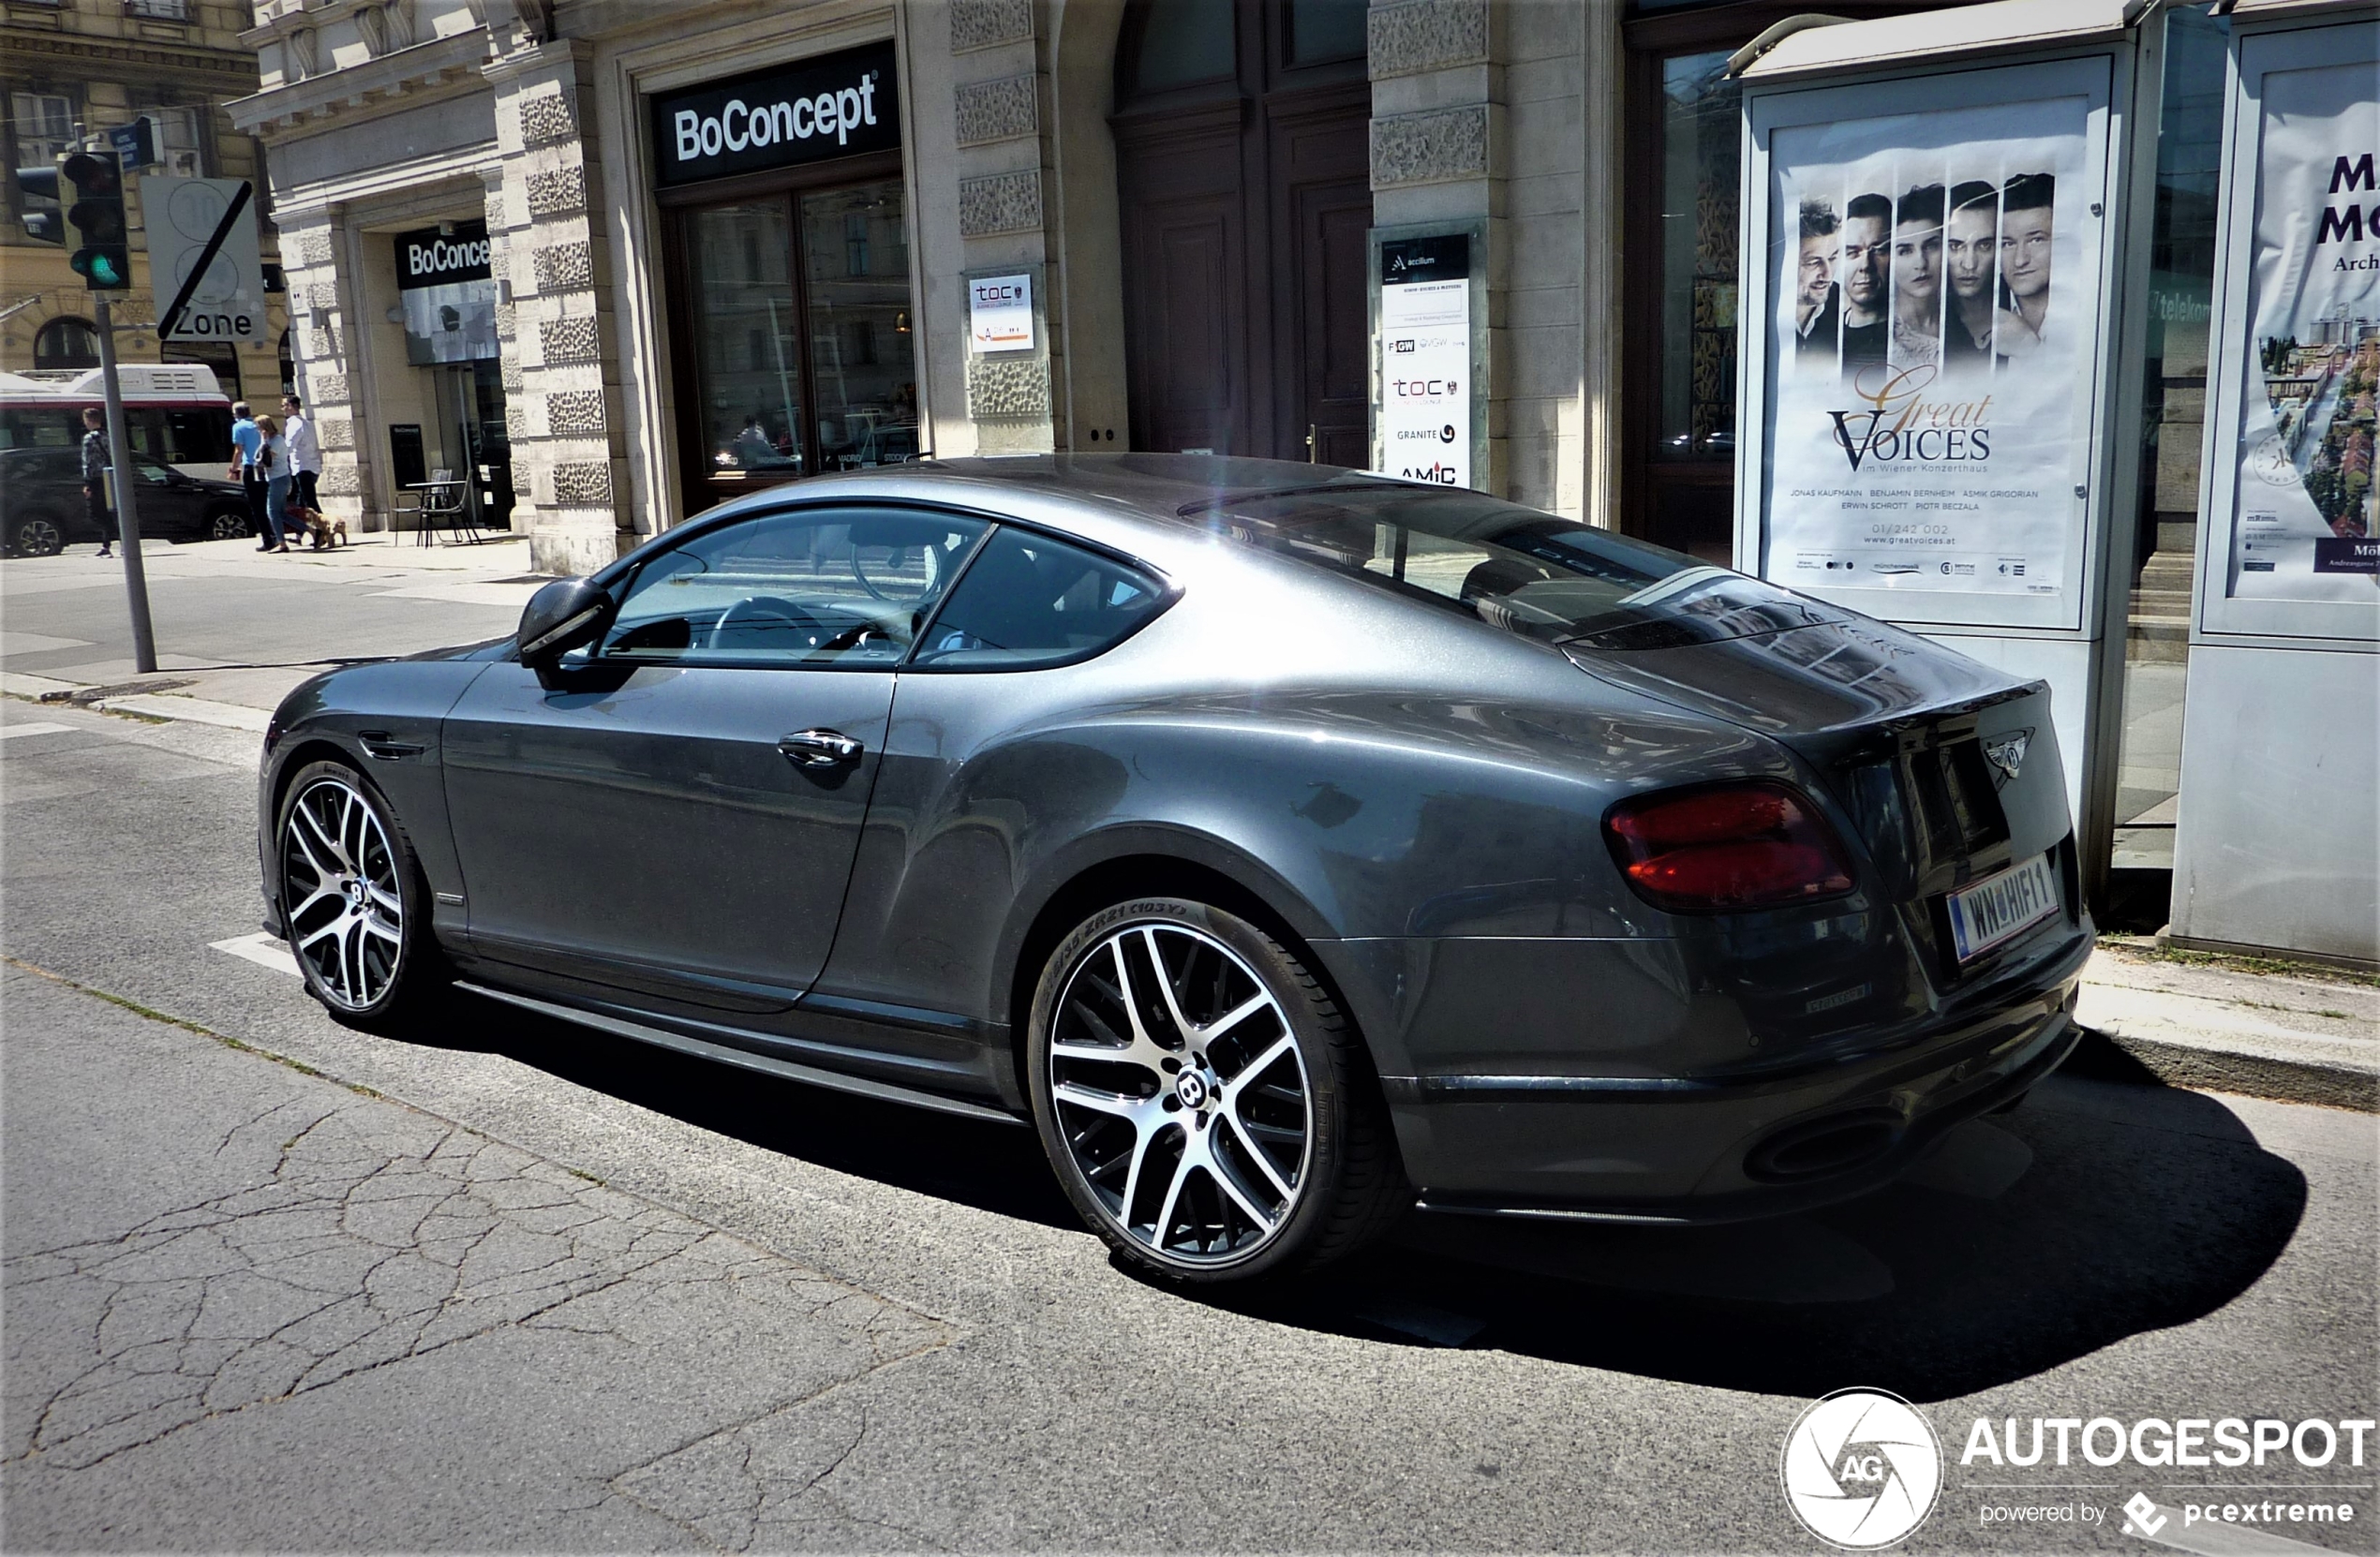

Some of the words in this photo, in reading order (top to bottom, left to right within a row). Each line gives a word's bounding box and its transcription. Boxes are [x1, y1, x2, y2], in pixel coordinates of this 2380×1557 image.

[675, 74, 876, 161] BoConcept
[174, 306, 252, 335] Zone
[1397, 430, 1437, 440] GRANITE
[1826, 410, 1991, 473] VOICES
[1863, 464, 1875, 473] im
[1880, 464, 1917, 473] Wiener
[1922, 463, 1988, 473] Konzerthaus
[1791, 489, 1816, 497] JONAS
[1818, 489, 1863, 497] KAUFMANN
[1869, 489, 1911, 497] BENJAMIN
[1913, 489, 1956, 497] BERNHEIM
[1963, 490, 1987, 498] ASMIK
[1990, 490, 2039, 498] GRIGORIAN
[1916, 502, 1940, 511] PIOTR
[1942, 502, 1979, 511] BECZALA
[1871, 525, 1917, 535] 01/242
[1924, 525, 1949, 535] 002
[1864, 536, 1956, 545] www.greatvoices.at
